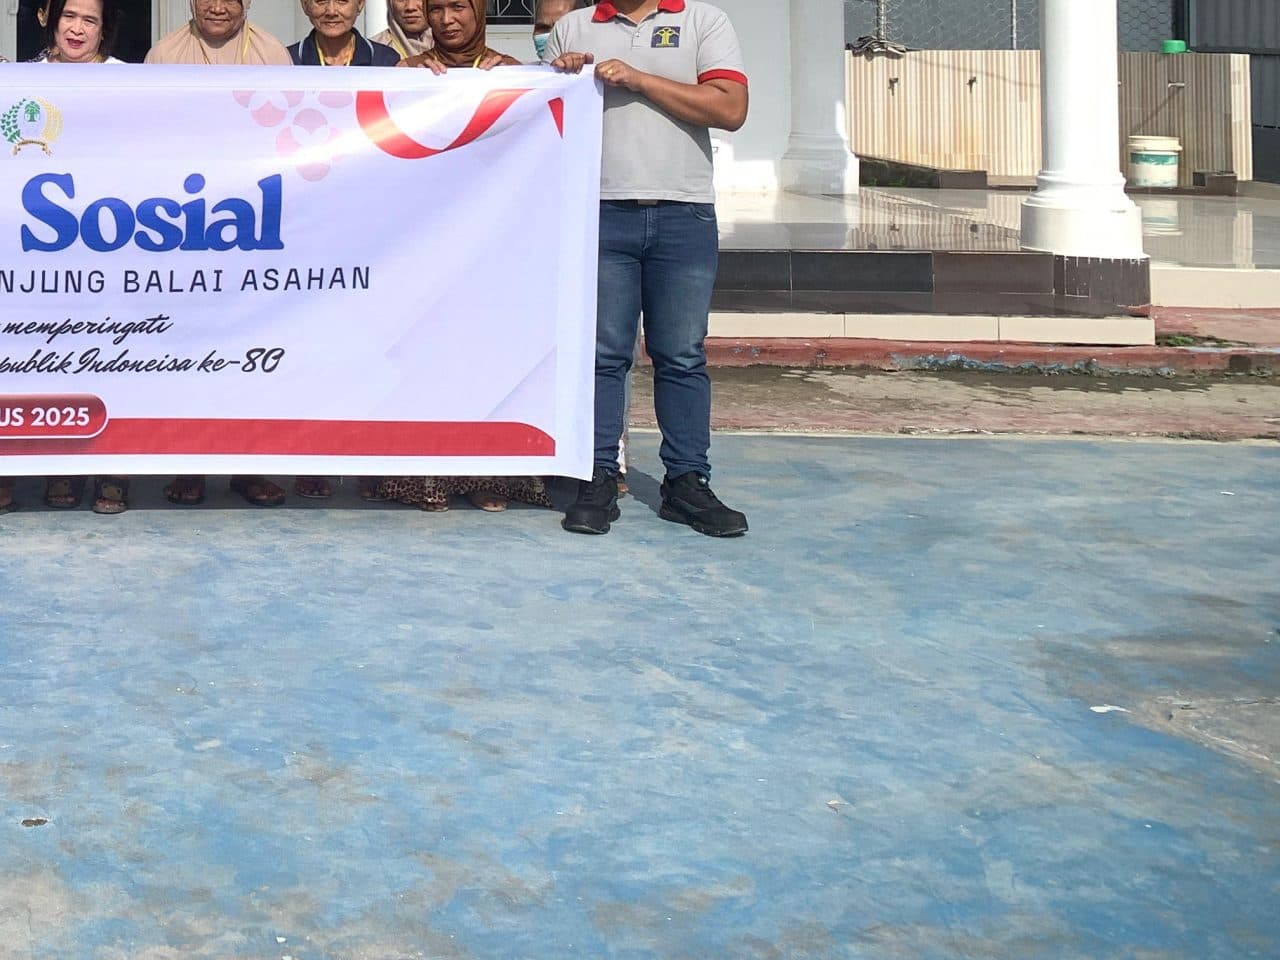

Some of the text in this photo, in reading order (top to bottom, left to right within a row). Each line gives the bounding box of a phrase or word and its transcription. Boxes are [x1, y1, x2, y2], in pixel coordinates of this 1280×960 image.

[20, 172, 285, 253] Sosial
[123, 269, 223, 293] BALAI
[240, 266, 370, 292] ASAHAN
[2, 314, 174, 345] memperingati
[72, 347, 198, 374] Indoneisa
[196, 347, 286, 373] ke-80
[30, 407, 90, 427] 2025
